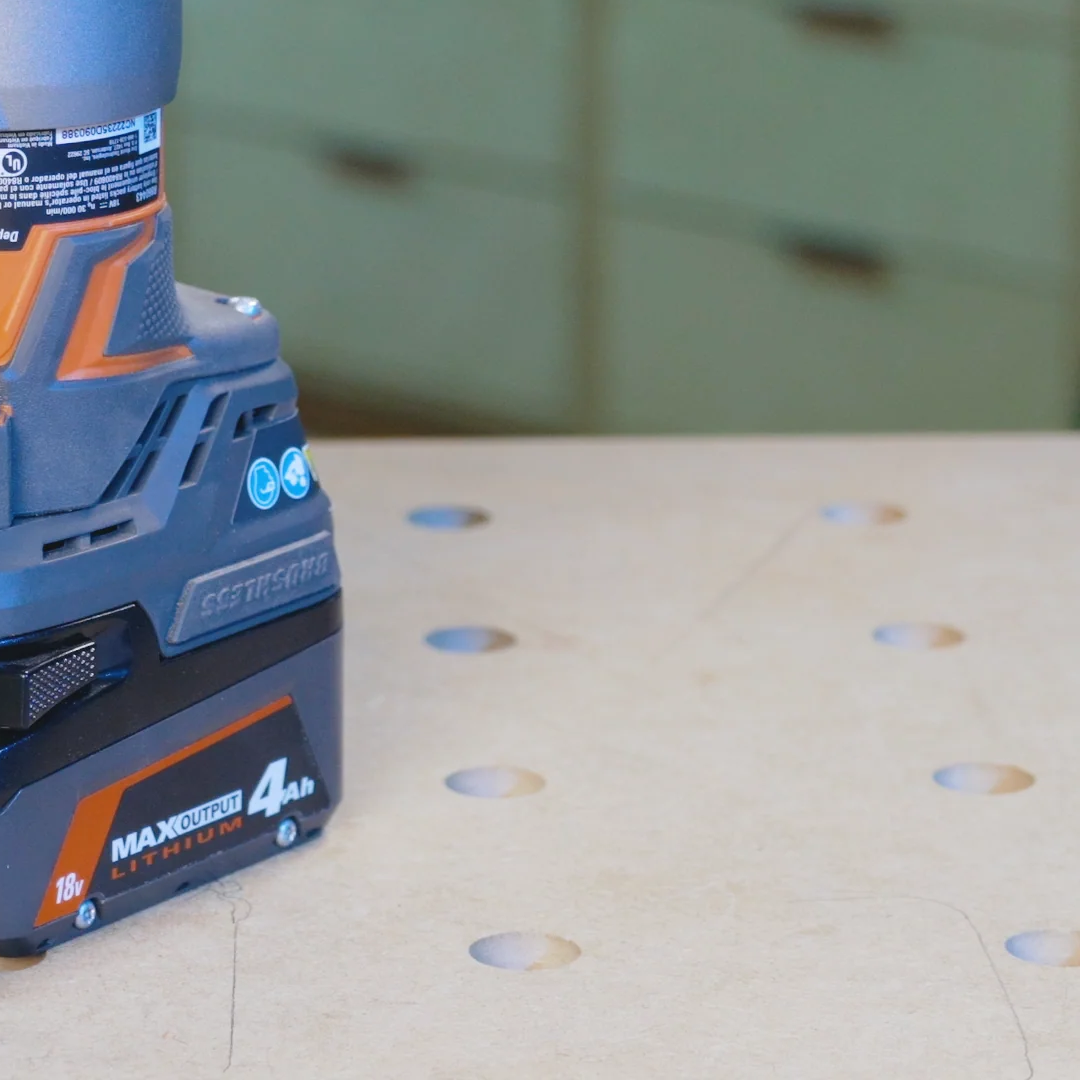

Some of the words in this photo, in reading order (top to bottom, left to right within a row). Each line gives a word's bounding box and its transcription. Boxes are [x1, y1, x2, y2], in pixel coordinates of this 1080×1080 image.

[62, 119, 135, 139] NC22235D090388
[6, 155, 21, 170] UL
[32, 173, 65, 183] operador
[67, 172, 77, 180] del
[79, 169, 103, 179] manual
[36, 181, 74, 191] solamente
[76, 179, 88, 187] Use
[70, 185, 100, 197] bloc-pile
[45, 194, 81, 207] operator's
[91, 193, 108, 201] listed
[15, 200, 42, 209] manual
[111, 816, 244, 880] LITHIUM
